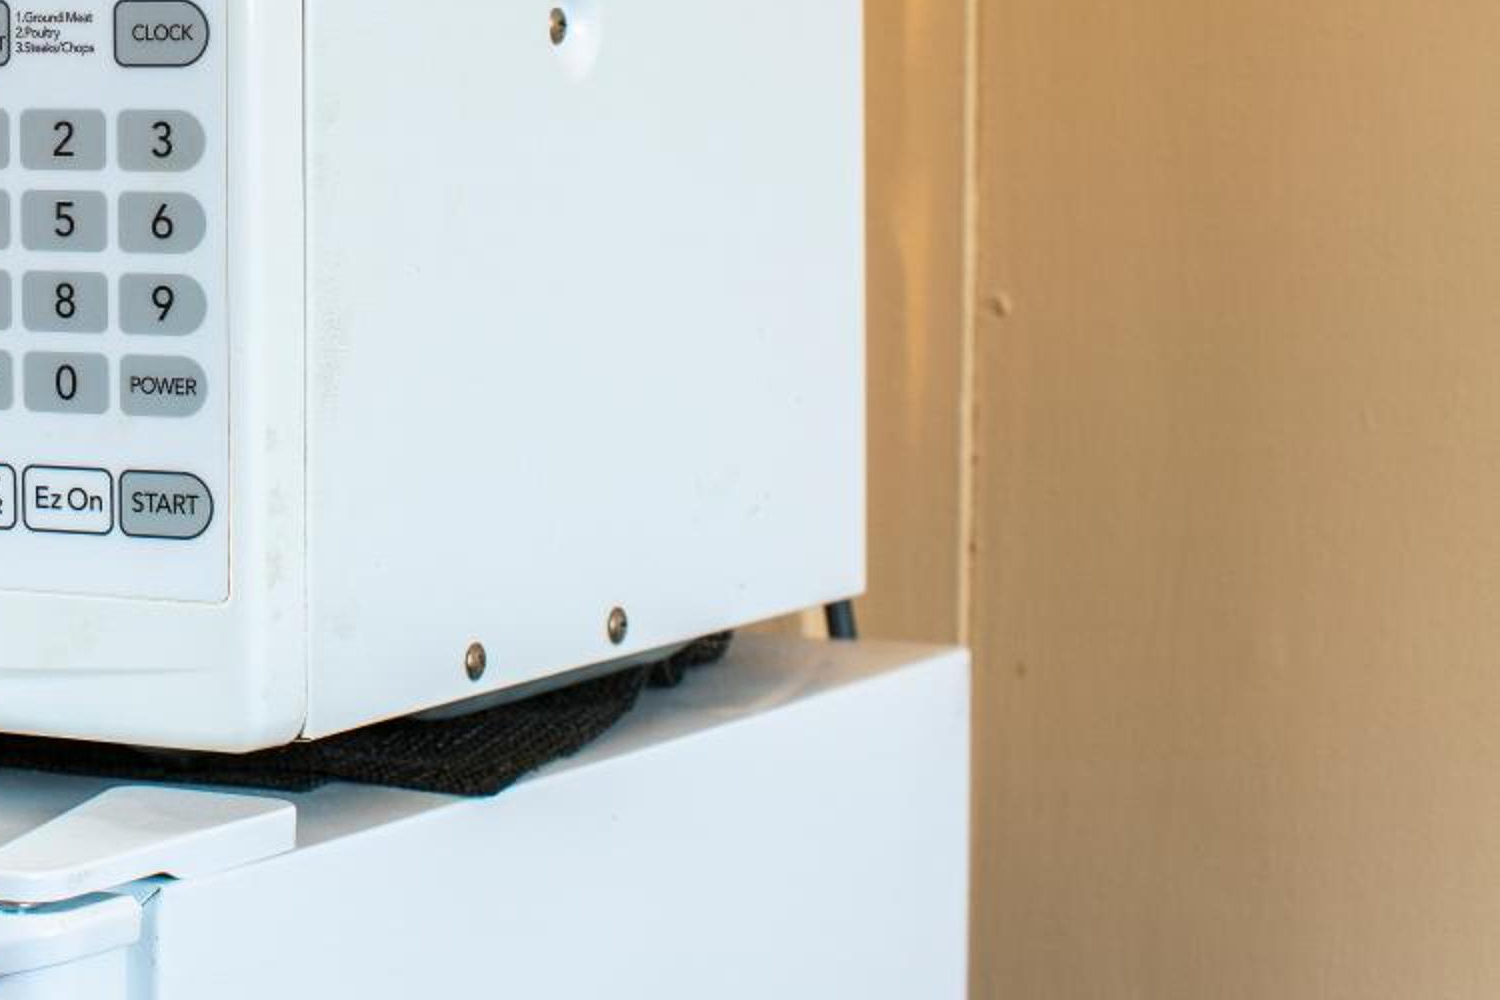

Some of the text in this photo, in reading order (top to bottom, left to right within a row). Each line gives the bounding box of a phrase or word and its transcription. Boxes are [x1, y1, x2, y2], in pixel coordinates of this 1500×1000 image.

[131, 23, 194, 41] CLOCK
[53, 121, 75, 157] 2
[151, 121, 173, 158] 3
[54, 201, 75, 237] 5
[151, 203, 173, 239] 6
[55, 282, 76, 319] 8
[151, 285, 174, 321] 9
[55, 364, 77, 400] 0
[129, 375, 197, 396] POWER
[35, 485, 103, 512] Ez On
[131, 491, 200, 516] START
